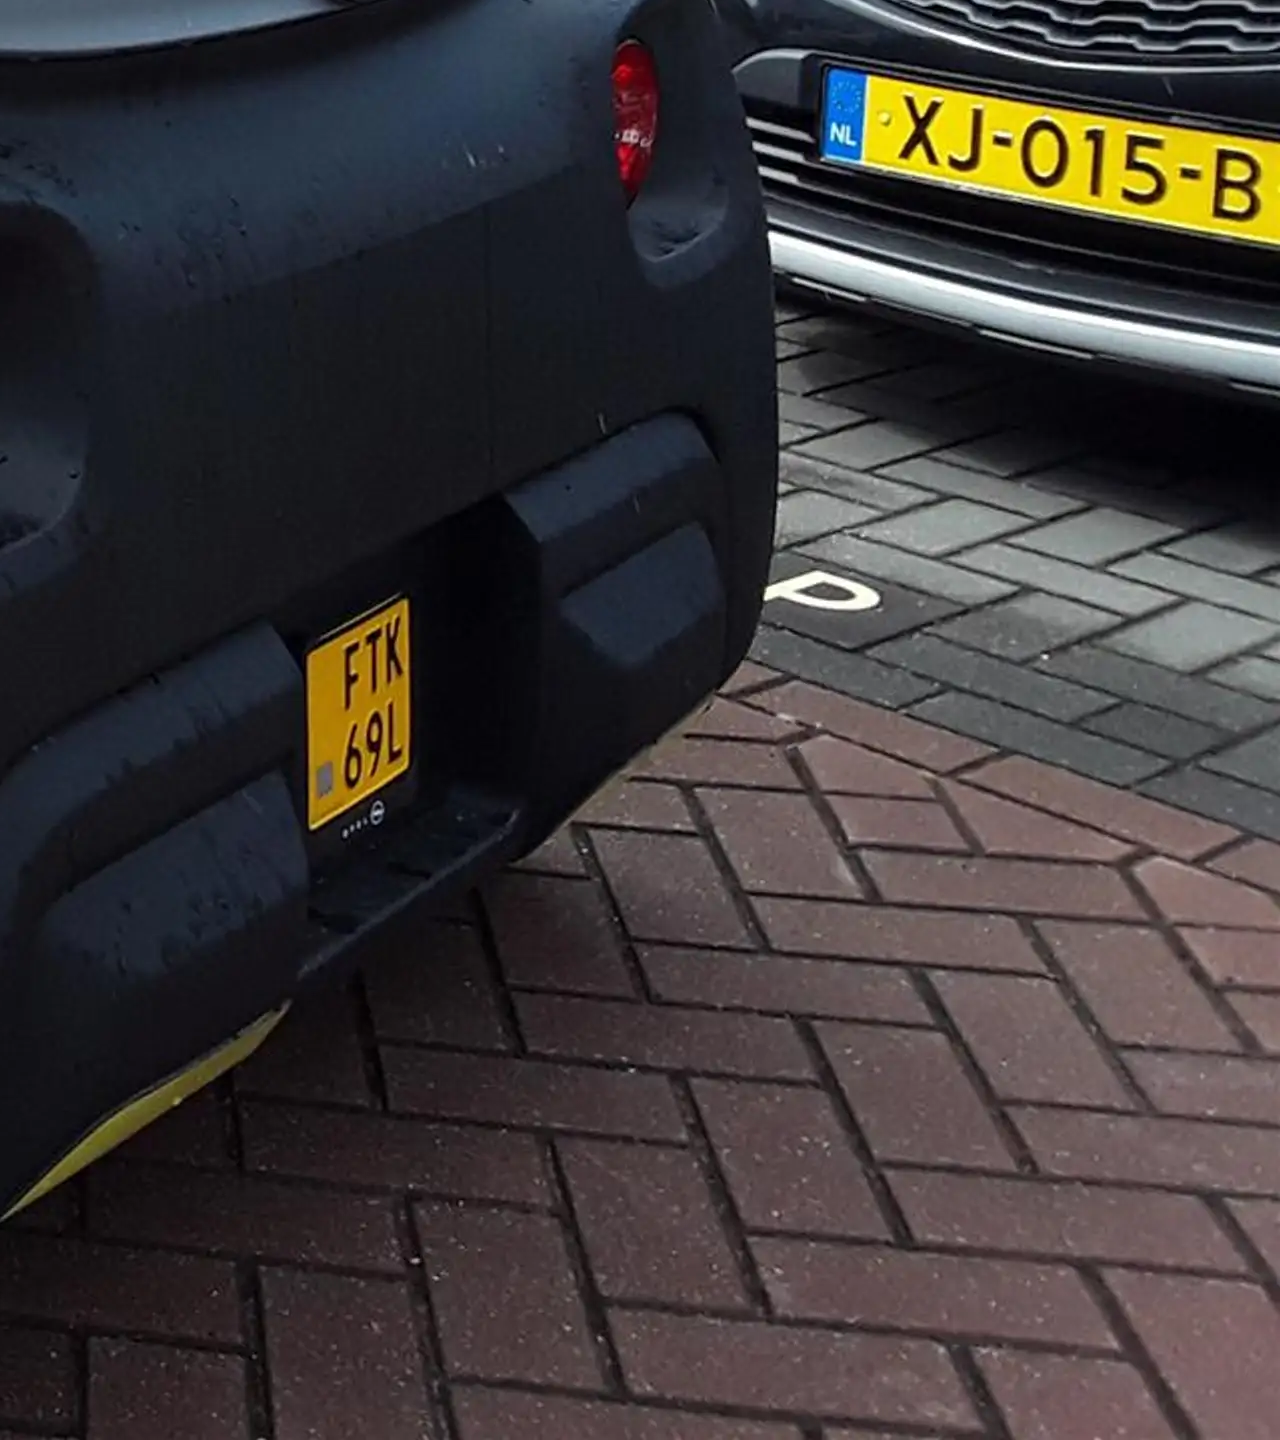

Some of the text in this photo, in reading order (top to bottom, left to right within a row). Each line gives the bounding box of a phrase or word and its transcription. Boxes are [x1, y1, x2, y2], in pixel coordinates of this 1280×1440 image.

[829, 121, 857, 148] NL
[897, 94, 1262, 224] XJ-015-B
[342, 615, 403, 712] FTK
[343, 700, 403, 790] 69L
